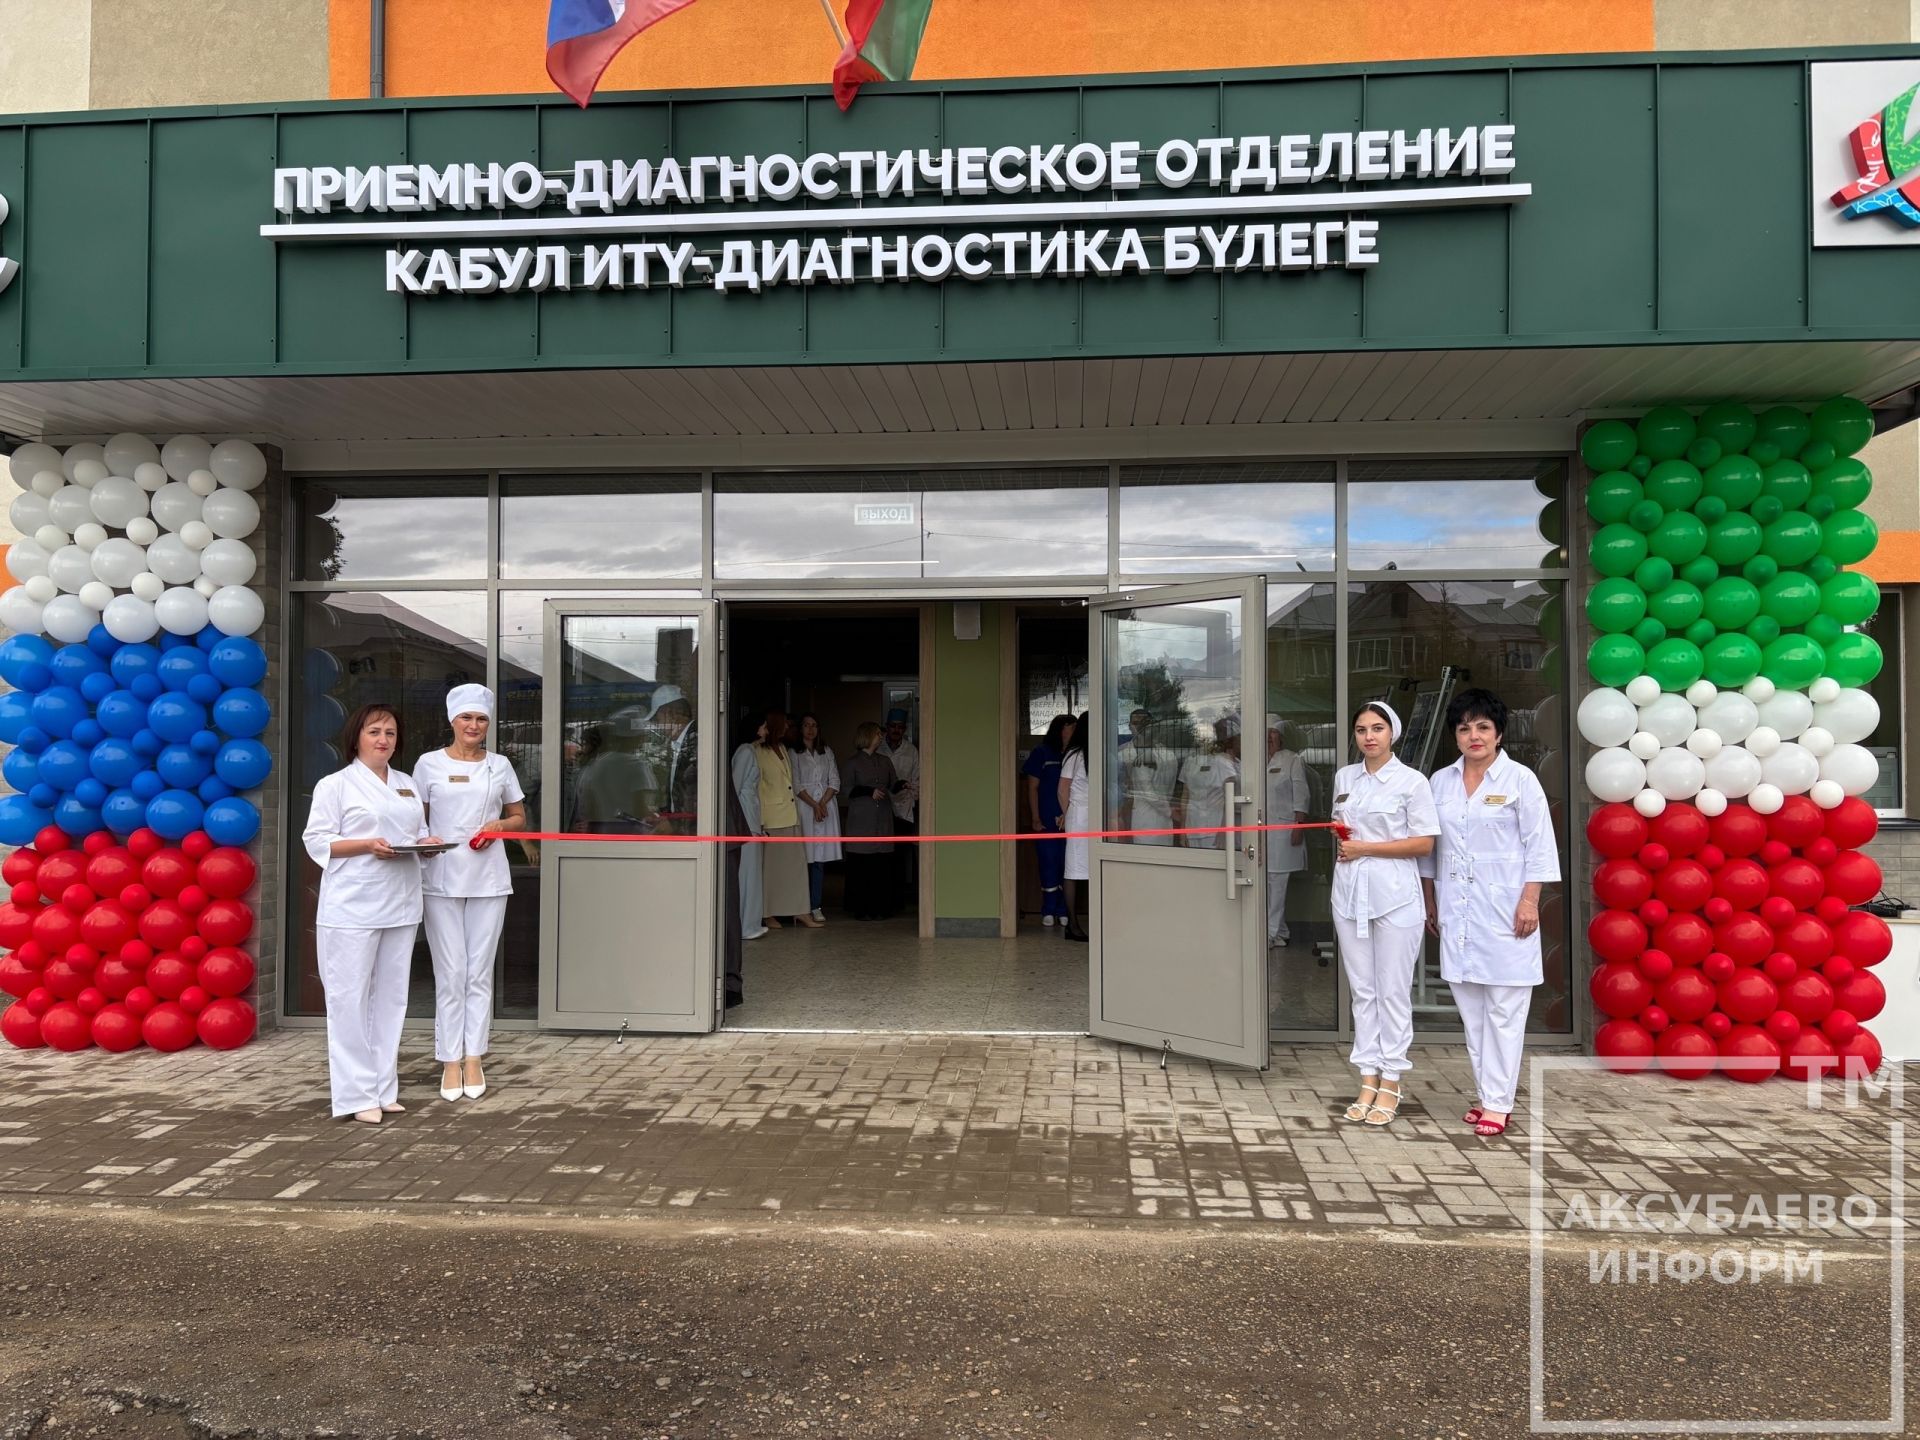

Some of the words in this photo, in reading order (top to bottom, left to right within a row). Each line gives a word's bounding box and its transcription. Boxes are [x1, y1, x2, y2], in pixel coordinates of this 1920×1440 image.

[274, 140, 1140, 214] ПРИЕМНО-ДИАГНОСТИЧЕСКОЕ
[1155, 125, 1516, 194] ОТДЕЛЕНИЕ
[386, 244, 571, 295] КАБУЛ
[1163, 220, 1380, 276] БҮЛЕГЕ
[863, 508, 907, 520] ВЫХОД
